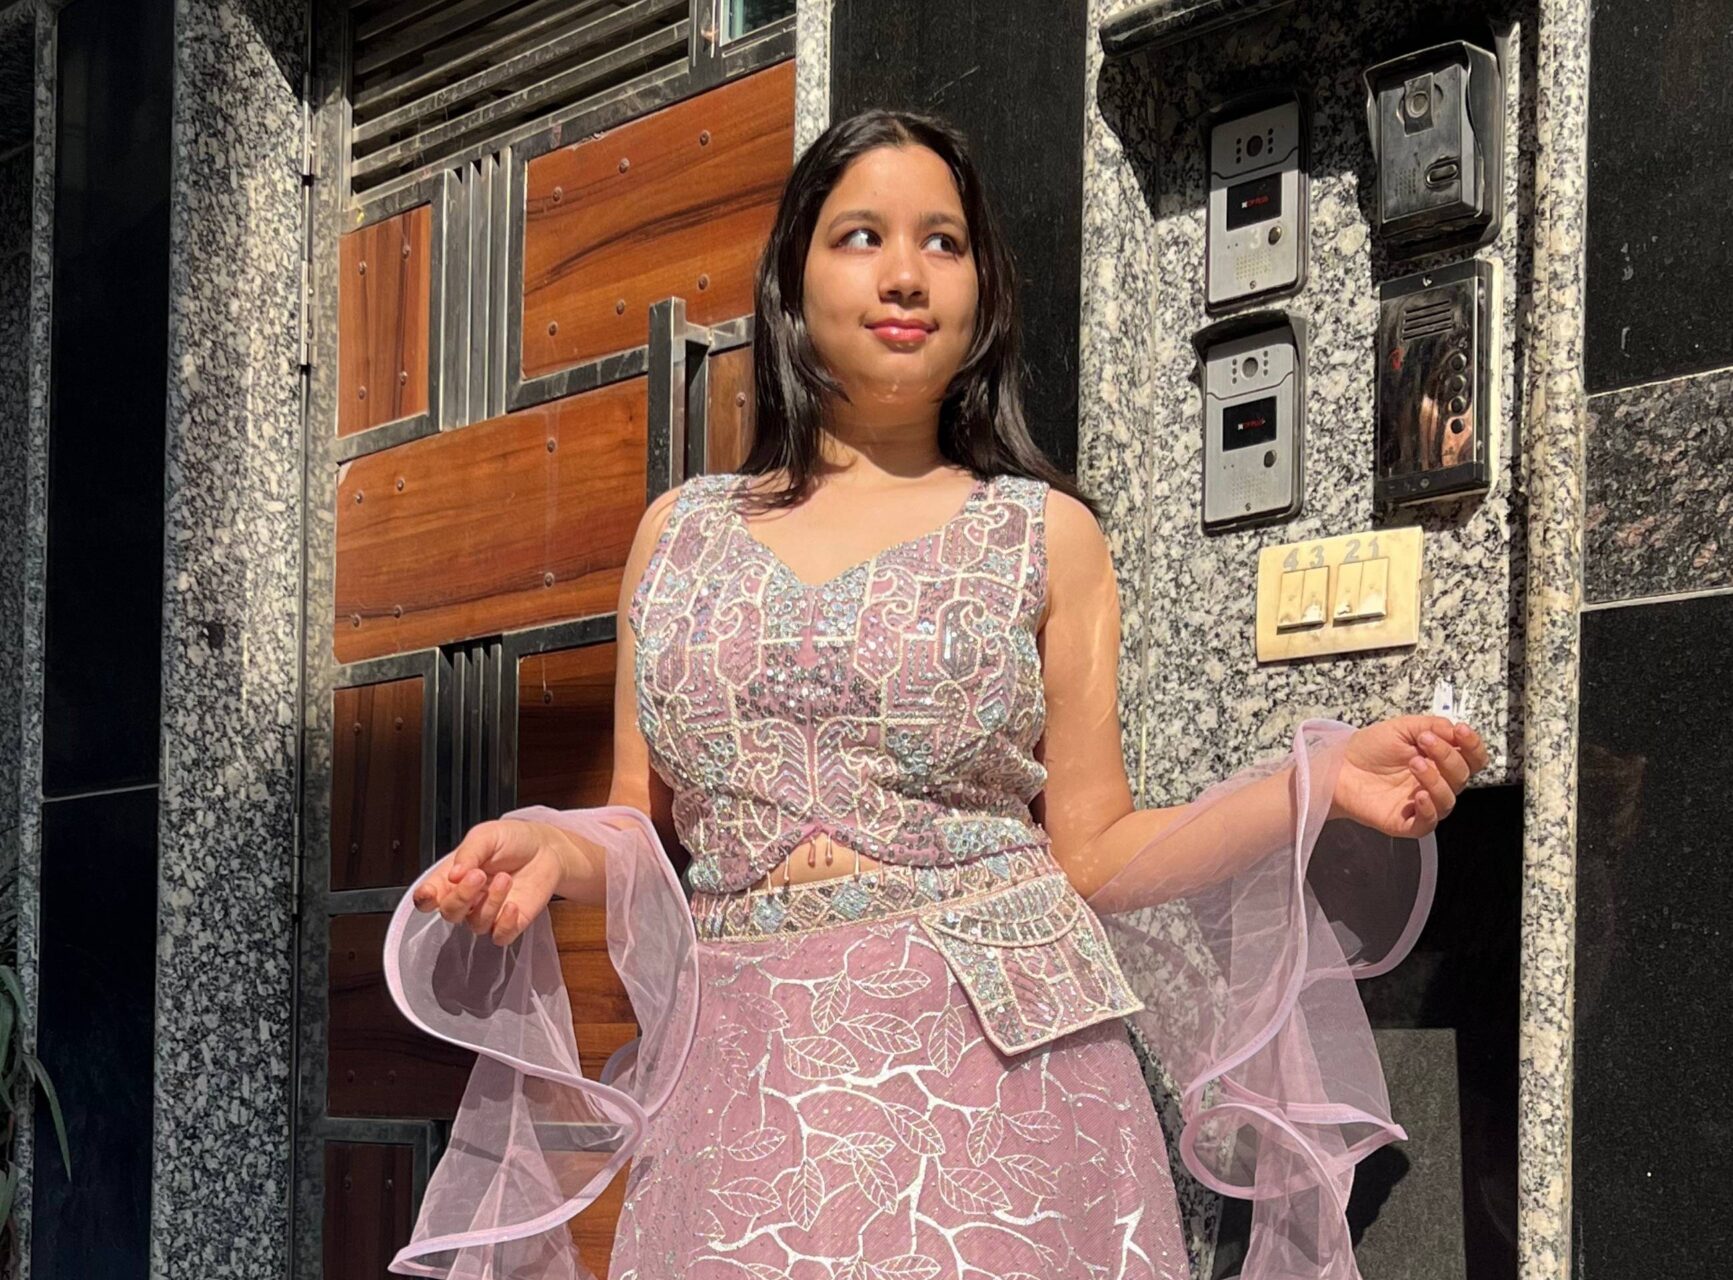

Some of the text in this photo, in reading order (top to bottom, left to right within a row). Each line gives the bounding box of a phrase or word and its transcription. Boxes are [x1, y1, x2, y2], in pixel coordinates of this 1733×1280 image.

[1250, 227, 1261, 249] 3
[1283, 536, 1380, 570] 4 3 2 1
